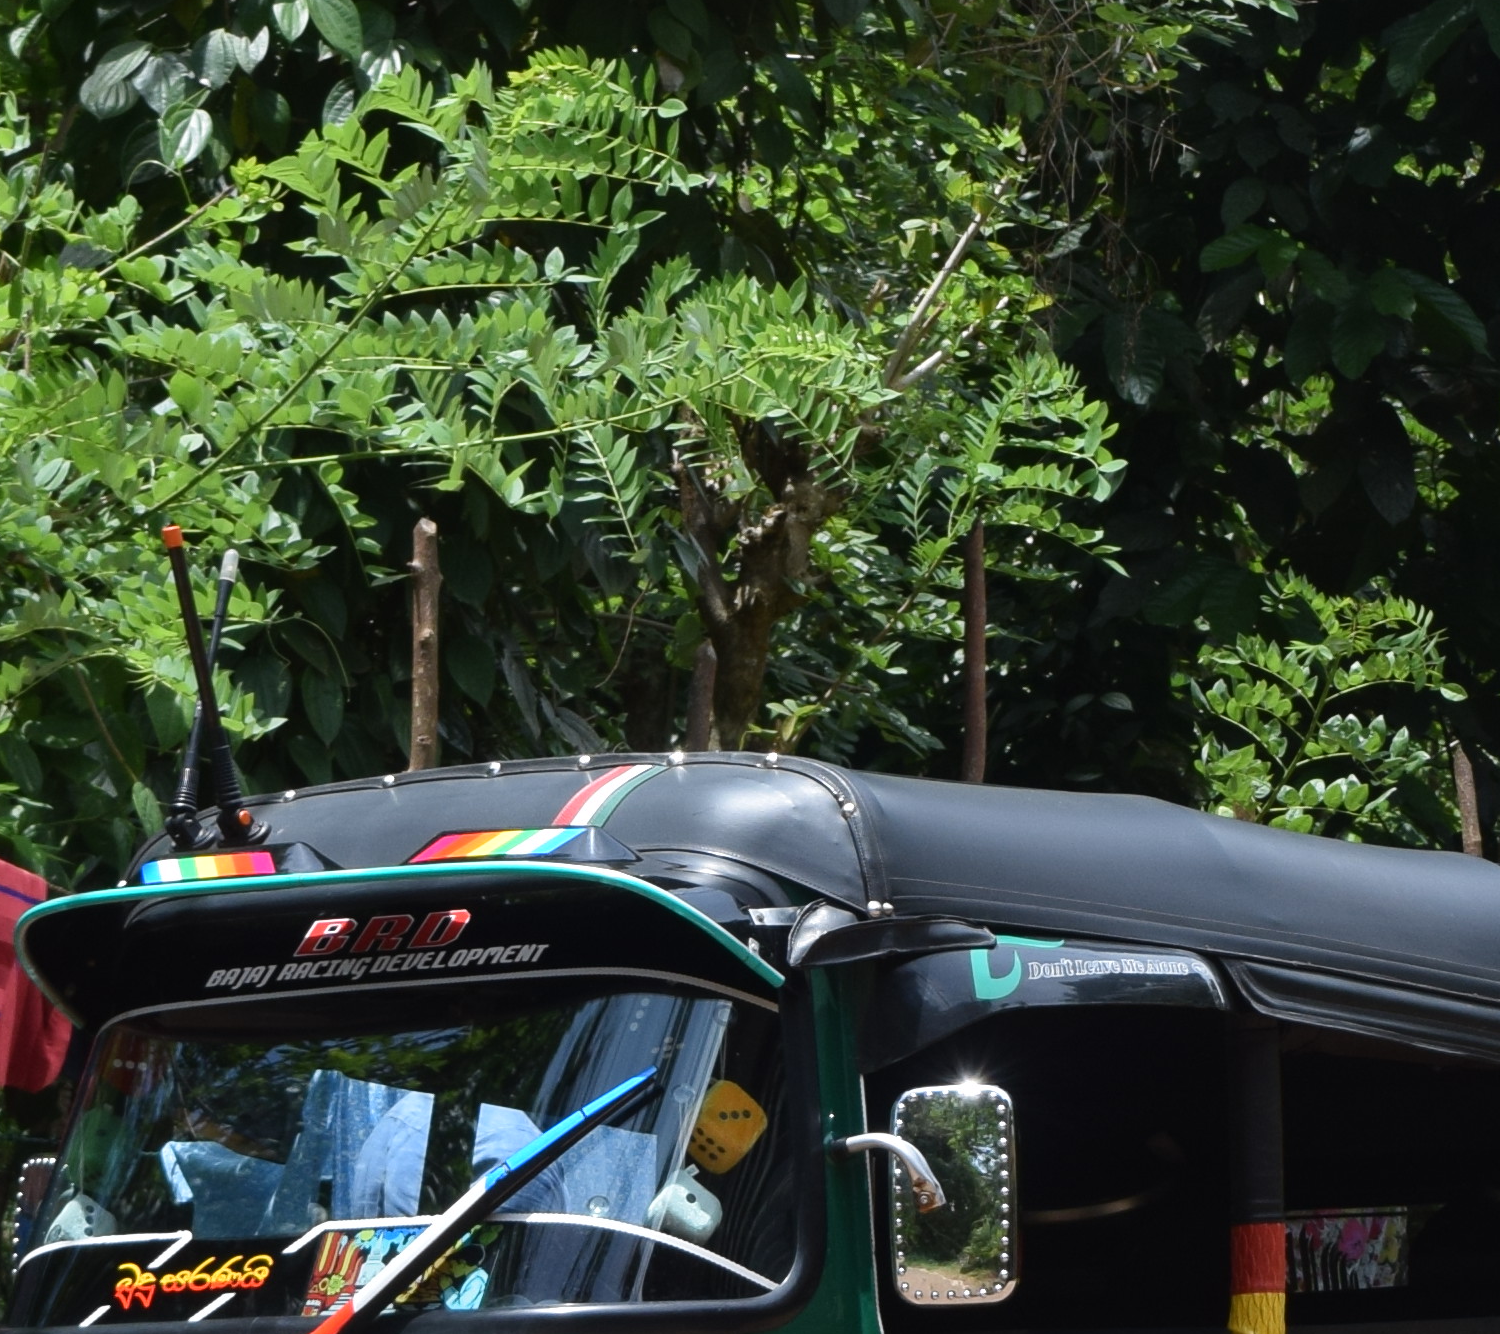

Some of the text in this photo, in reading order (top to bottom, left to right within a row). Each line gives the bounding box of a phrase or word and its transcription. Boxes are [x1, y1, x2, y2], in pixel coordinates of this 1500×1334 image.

[293, 909, 471, 957] BRD
[205, 944, 549, 990] BAJAJ RACING DEVELOPMENT
[1027, 958, 1190, 980] Don't Leave Me Alone
